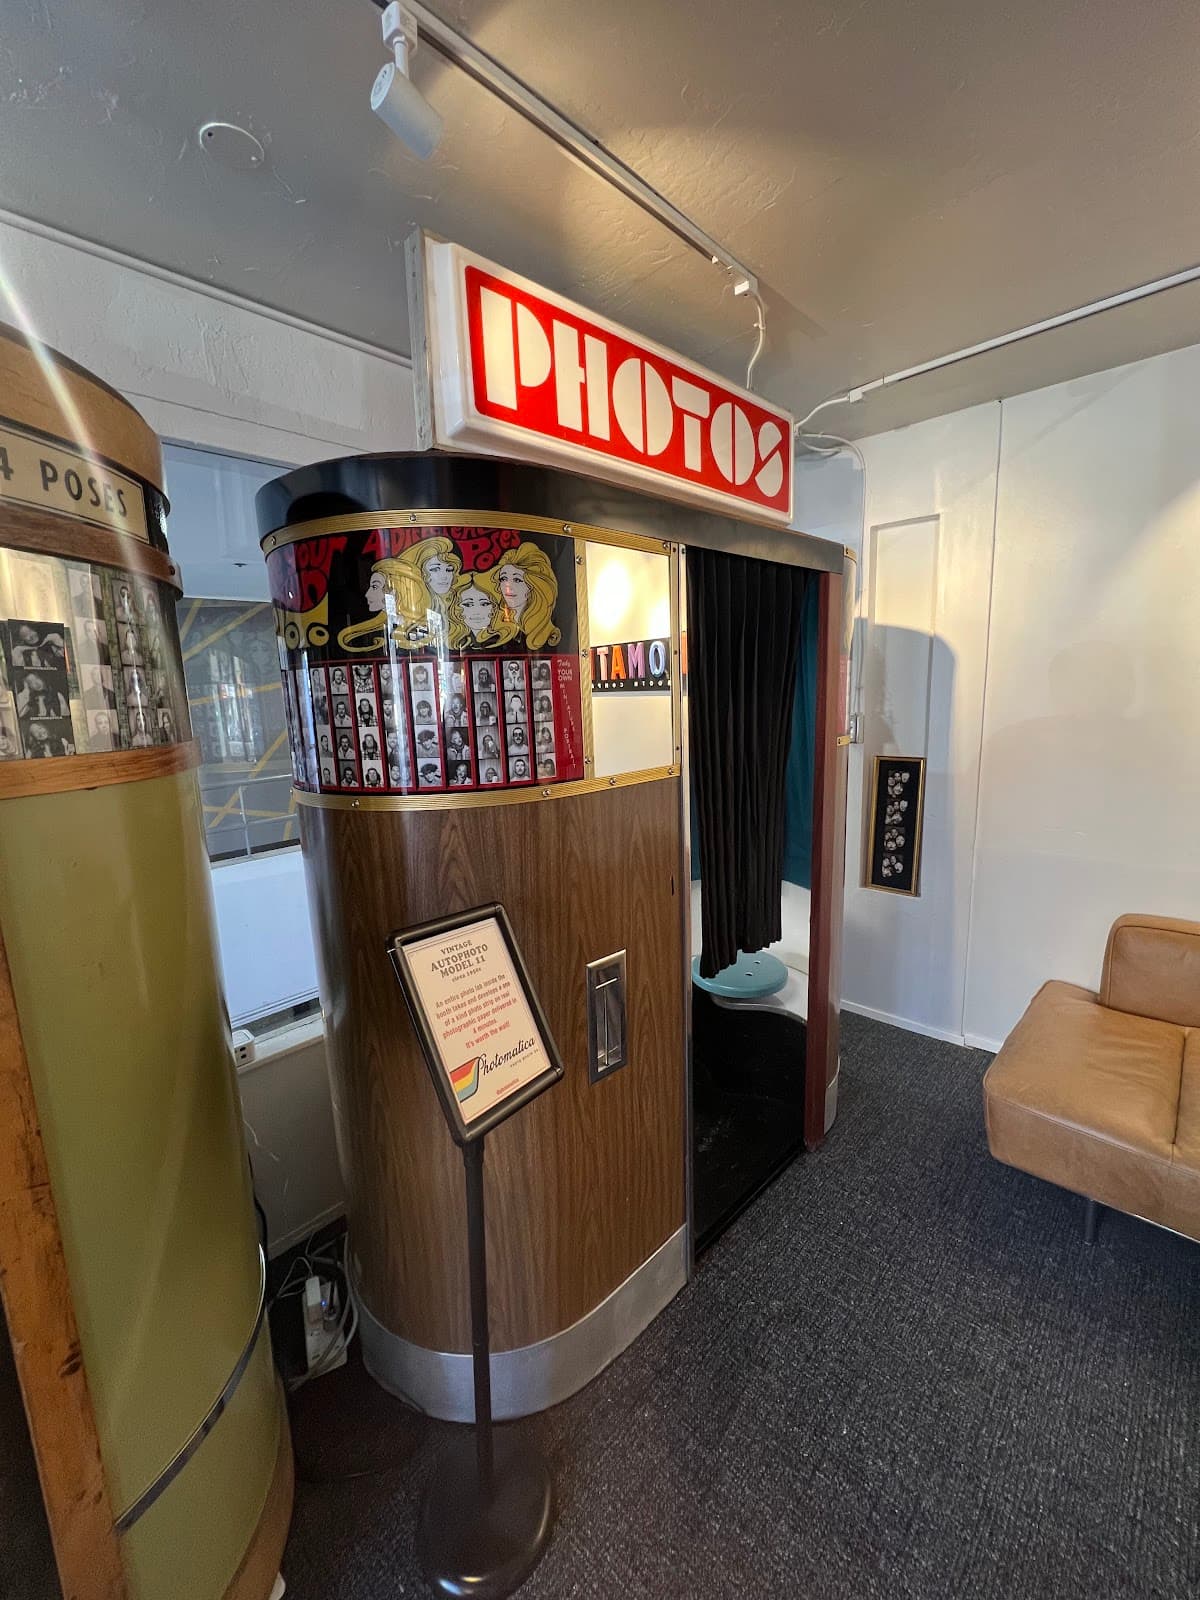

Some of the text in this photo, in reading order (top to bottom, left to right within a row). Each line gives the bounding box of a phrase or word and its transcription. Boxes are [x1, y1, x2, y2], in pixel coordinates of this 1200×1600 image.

[480, 286, 784, 498] PHOTOS
[39, 458, 128, 517] POSES
[431, 943, 488, 971] AUTOPHOTO
[440, 940, 472, 955] VINTAGE
[440, 955, 486, 978] MODEL 11
[460, 987, 474, 998] photo
[444, 1018, 450, 1026] of
[456, 1011, 467, 1020] kind
[468, 1005, 482, 1016] photo
[452, 1001, 467, 1011] takes
[443, 1017, 476, 1039] photographic
[477, 1010, 491, 1022] paper
[475, 1032, 489, 1043] worth
[489, 1028, 498, 1036] the
[477, 1037, 535, 1076] Photomatica
